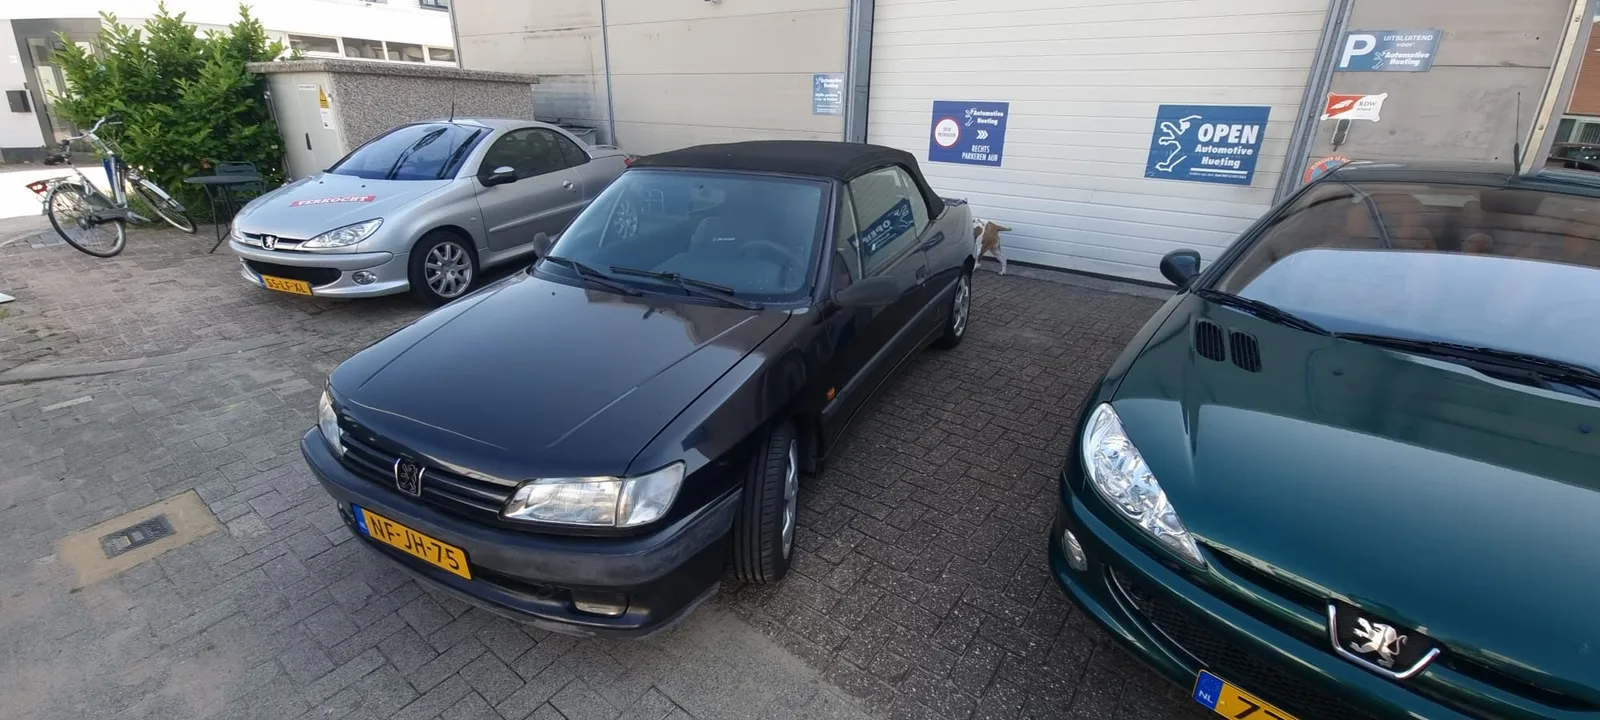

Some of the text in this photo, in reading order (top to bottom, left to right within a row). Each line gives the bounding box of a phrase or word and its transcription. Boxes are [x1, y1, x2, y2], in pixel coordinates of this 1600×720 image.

[1339, 34, 1377, 68] P
[1384, 51, 1430, 59] Automotive
[1389, 58, 1421, 67] Hueting
[972, 110, 1005, 118] Automotive
[977, 117, 999, 126] Hueting
[1197, 123, 1260, 145] OPEN
[971, 144, 990, 153] RECHTS
[1194, 144, 1254, 156] Automotive
[961, 152, 999, 162] PARKEREN AUB
[1201, 156, 1241, 169] Hueting
[297, 196, 369, 206] VERKOCHT
[369, 515, 460, 571] NF-JH-75
[1198, 689, 1214, 704] NL
